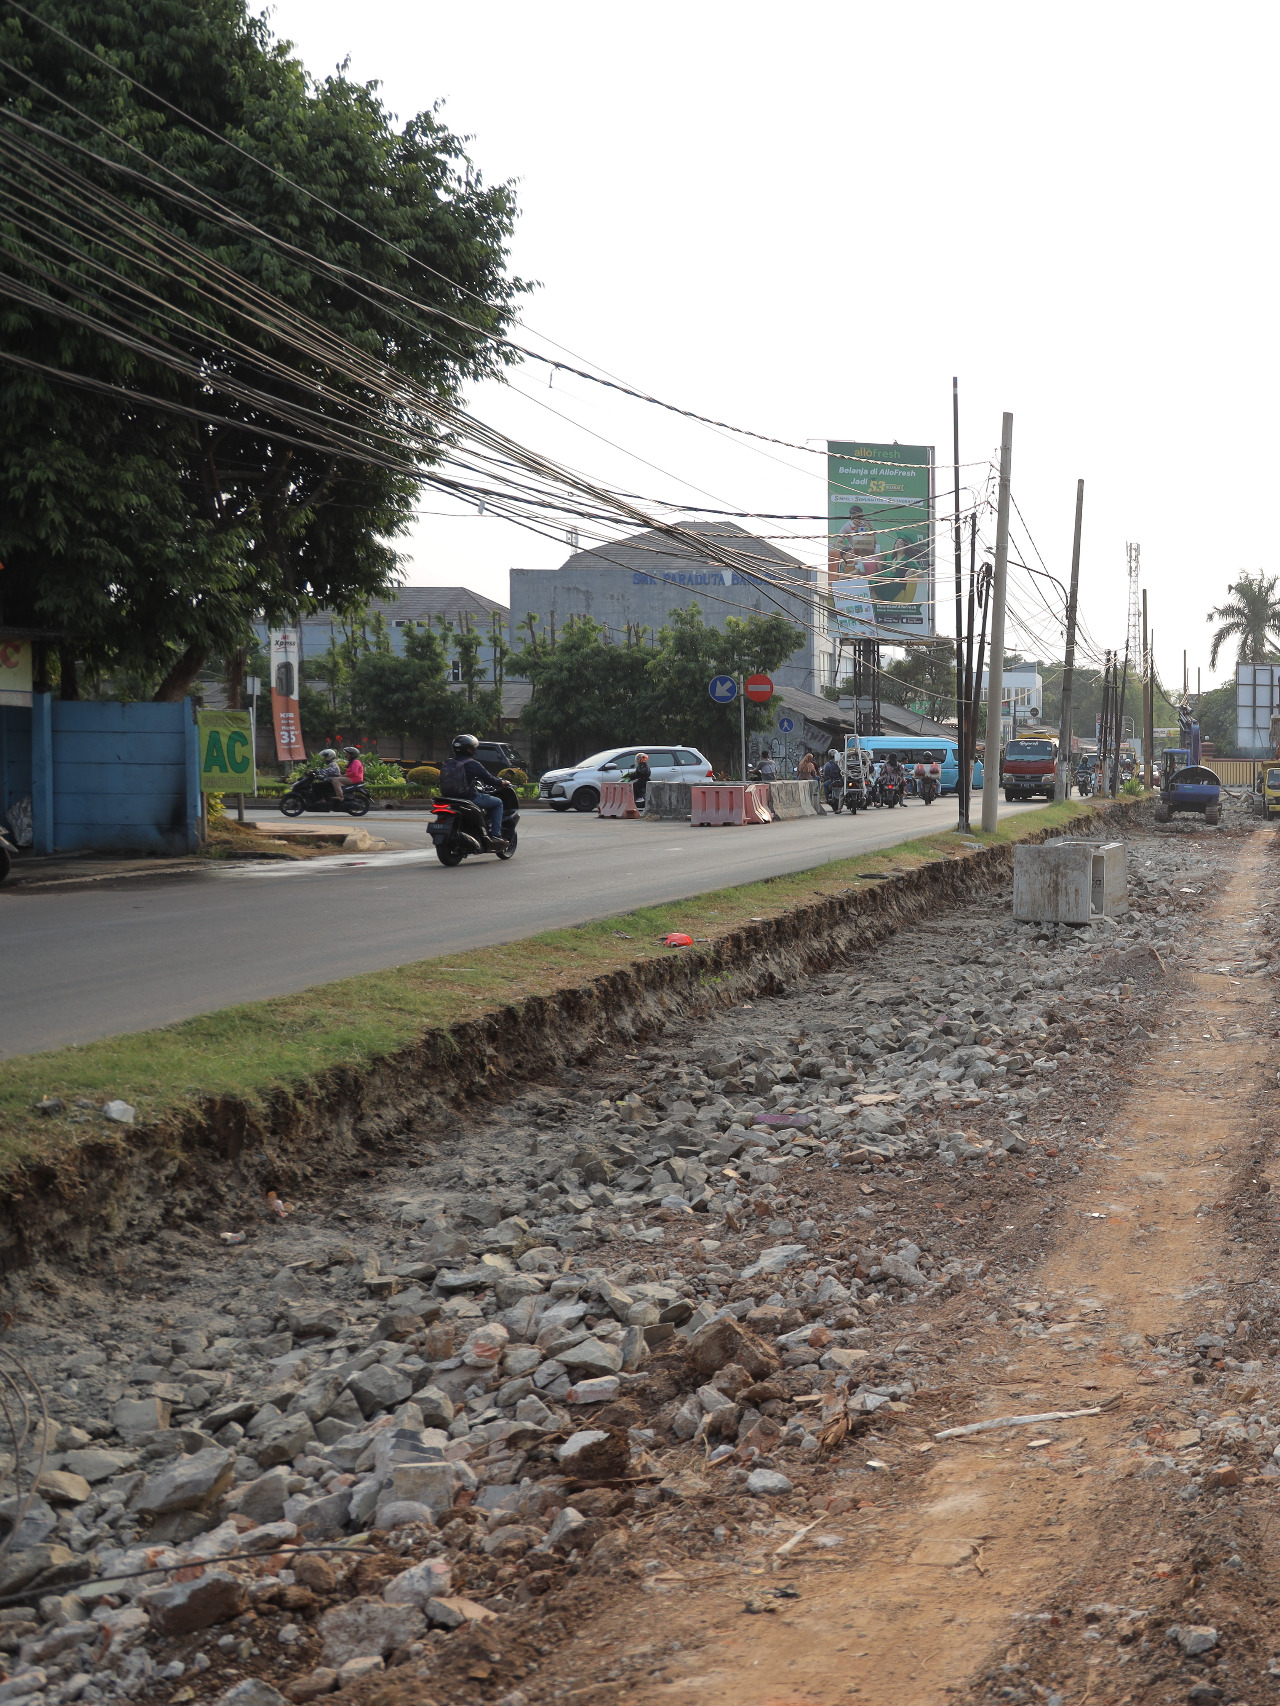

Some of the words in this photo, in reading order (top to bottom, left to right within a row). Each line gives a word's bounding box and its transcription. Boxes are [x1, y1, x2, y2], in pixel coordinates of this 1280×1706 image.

[839, 466, 869, 476] Belanja
[870, 467, 878, 475] di
[879, 468, 916, 477] AlloFresh
[632, 573, 657, 585] SMK
[203, 730, 250, 774] AC
[204, 776, 252, 788] MOBIL
